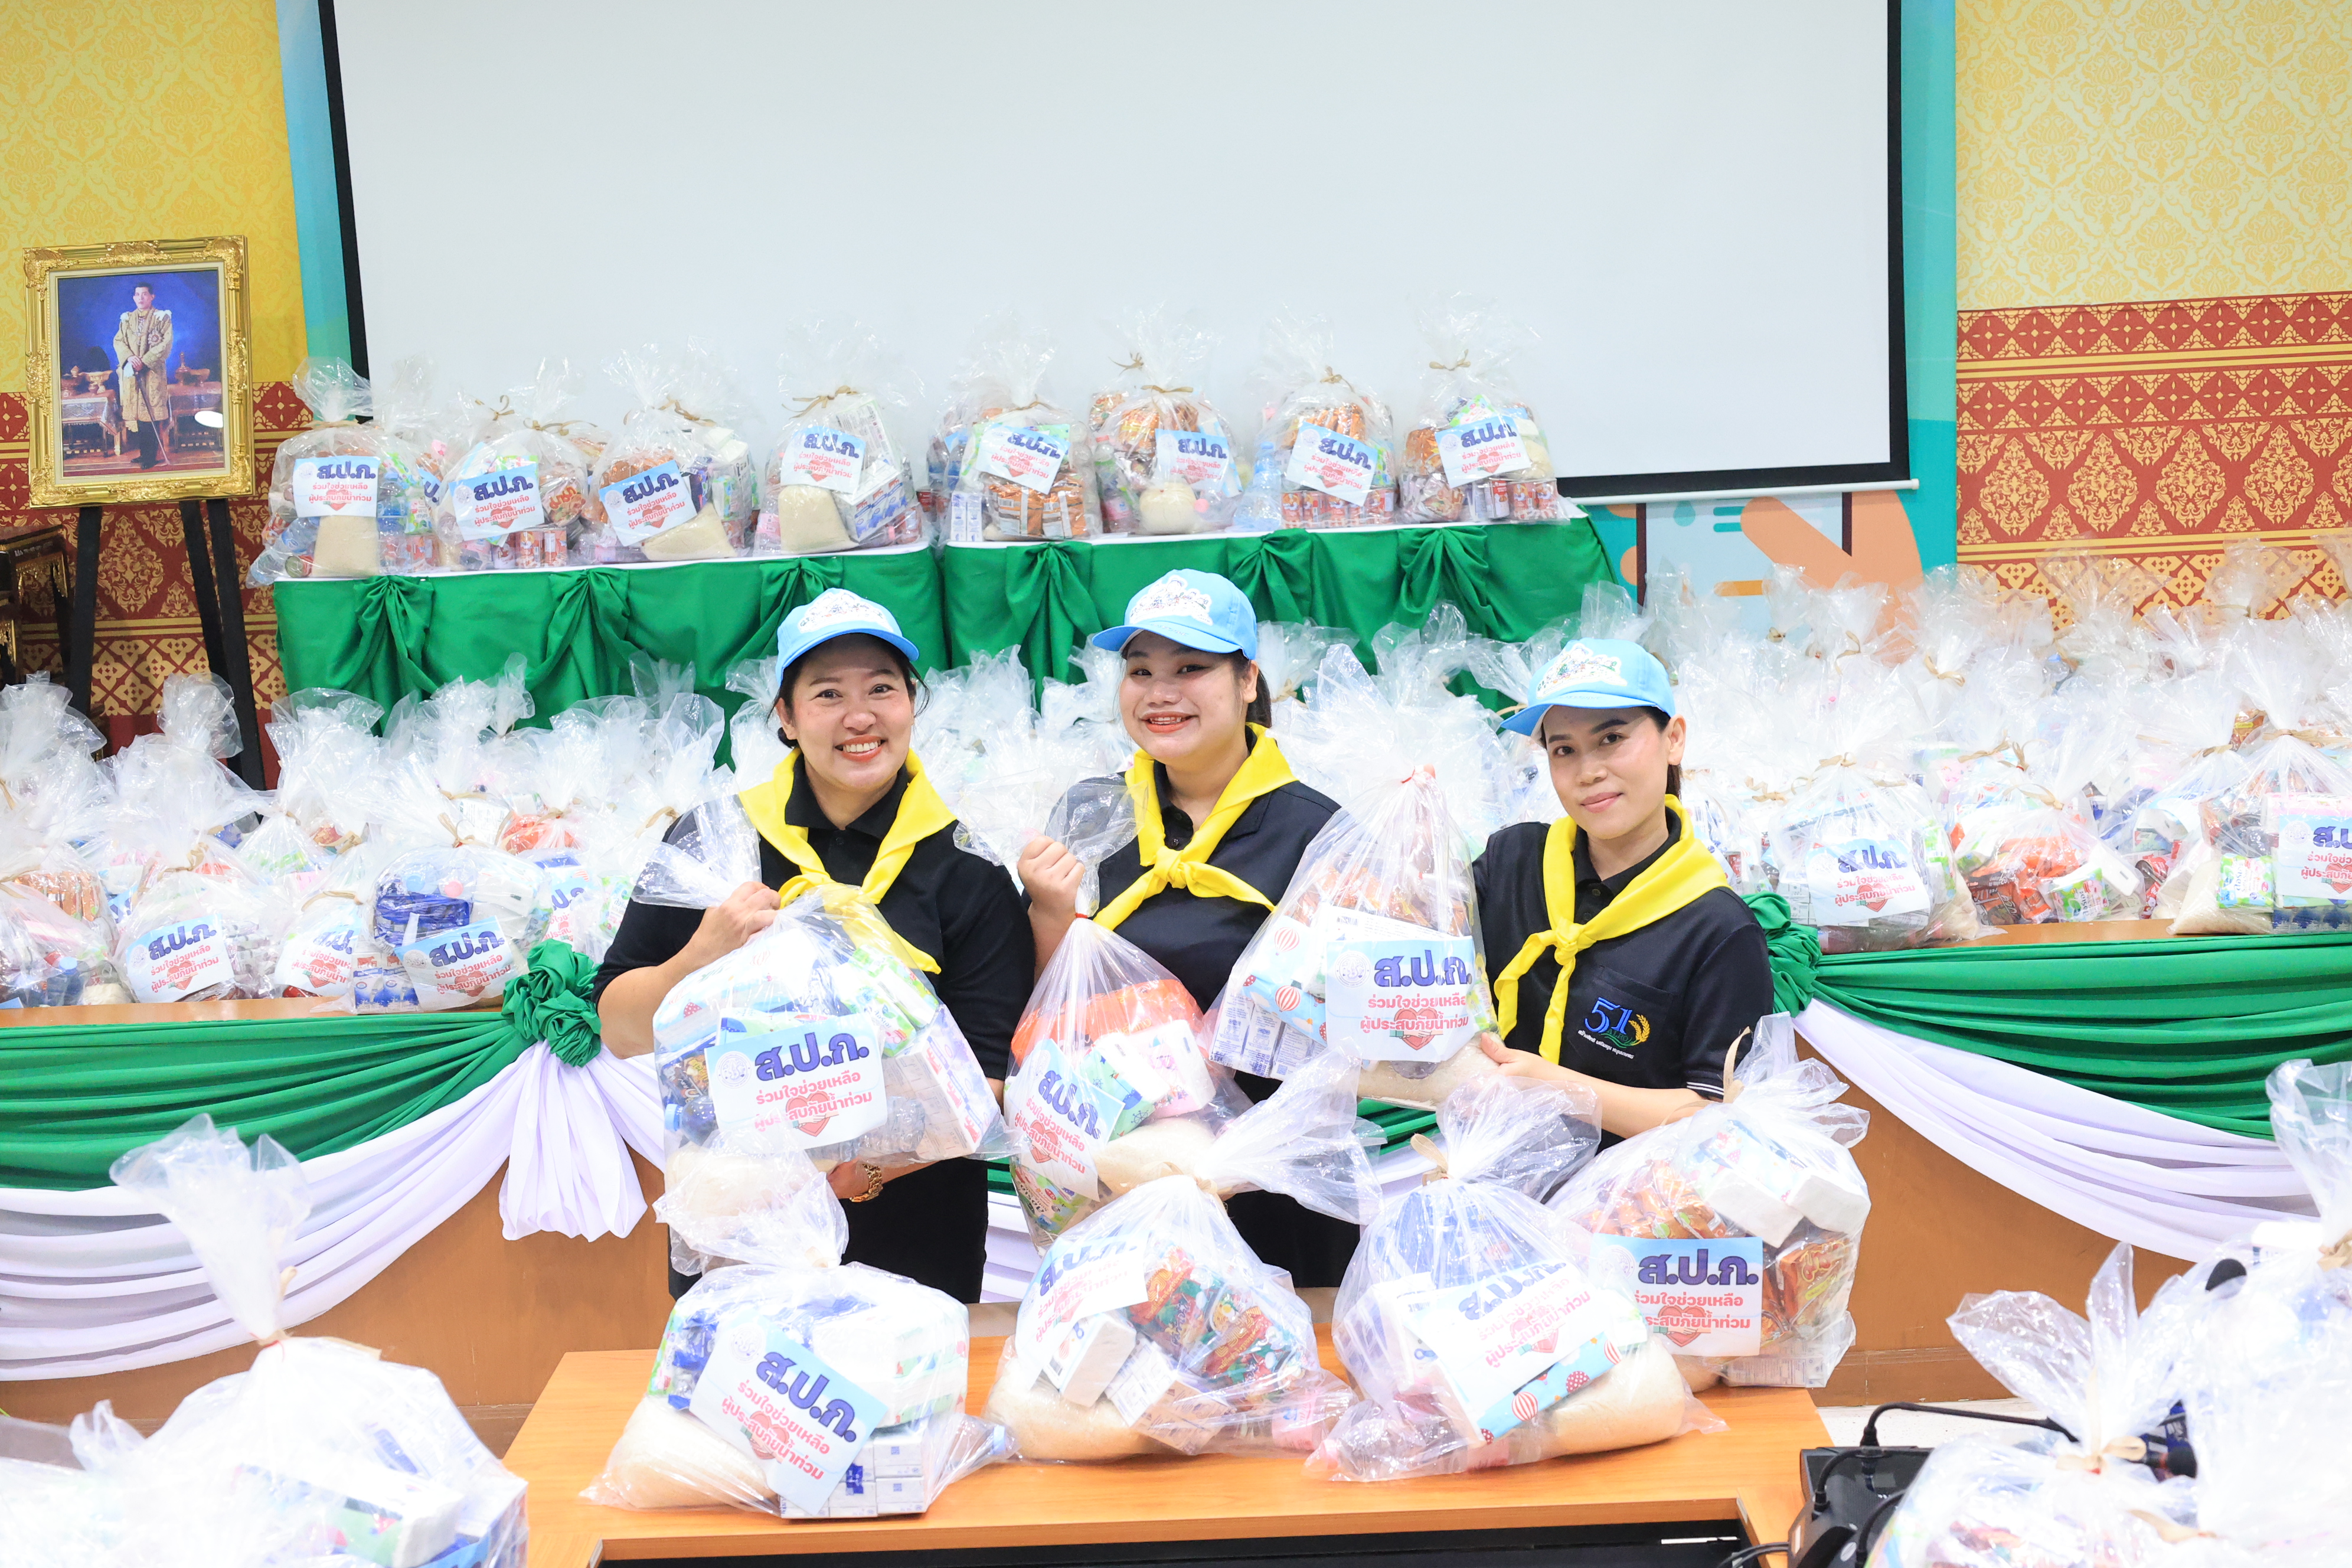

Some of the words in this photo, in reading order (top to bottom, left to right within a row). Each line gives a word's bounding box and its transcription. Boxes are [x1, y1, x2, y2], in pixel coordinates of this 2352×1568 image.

[804, 433, 860, 459] ส.ป.ก.
[1007, 433, 1061, 459] ส.ป.ก.
[1177, 439, 1227, 459] ส.ป.ก.
[1461, 422, 1517, 448] ส.ป.ก.
[1318, 437, 1371, 470] ส.ป.ก.
[317, 461, 376, 479] ส.ป.ก.
[309, 491, 372, 503] ผู้ประสบภัยน้ำท่วม
[312, 482, 368, 491] ร่วมใจช่วยเหลือ
[473, 475, 533, 501] ส.ป.ก.
[623, 471, 679, 503] ส.ป.ก.
[474, 505, 535, 525] ผู้ประสบภัยน้ำท่วม
[475, 495, 530, 514] ร่วมใจช่วยเหลือ
[627, 491, 677, 515] ร่วมใจช่วยเหลือ
[628, 501, 685, 529] ผู้ประสบภัยน้ำท่วม
[1838, 845, 1907, 873] ส.ป.ก.
[1834, 884, 1916, 906] ผู้ประสบภัยน้ำท่วม
[149, 924, 217, 960] ส.ป.ก.
[429, 931, 504, 966] ส.ป.ก.
[151, 945, 211, 976] ร่วมใจช่วยเหลือ
[152, 957, 219, 993] ผู้ประสบภัยน้ำท่วม
[435, 954, 502, 979] ร่วมใจช่วยเหลือ
[1374, 950, 1472, 987] ส.ป.ก.
[437, 964, 511, 994] ผู้ประสบภัยน้ำท่วม
[1360, 1013, 1469, 1034] ผู้ประสบภัยน้ำท่วม
[1585, 997, 1633, 1035] 51
[1606, 1029, 1629, 1042] ALRO
[754, 1033, 869, 1082] ส.ป.ก.
[755, 1070, 861, 1105] ร่วมใจช่วยเหลือ
[754, 1092, 873, 1132] ผู้ปสบภัยน้ำท่วม
[1038, 1070, 1102, 1139] ส.ป.ก.
[1026, 1097, 1085, 1152] ร่วมใจช่วยเหลือ
[1015, 1112, 1086, 1174] ผู้ประสบภัยน้ำท่วม
[1638, 1249, 1759, 1285] ส.ป.ก.
[1645, 1311, 1750, 1329] ระสบภัยน้ำท่วม
[756, 1351, 858, 1443] ส.ป.ก.
[738, 1379, 830, 1455] ร่วมใจช่วยเหลือ
[721, 1396, 824, 1481] ผู้ประสบภัยน้ำท่วม
